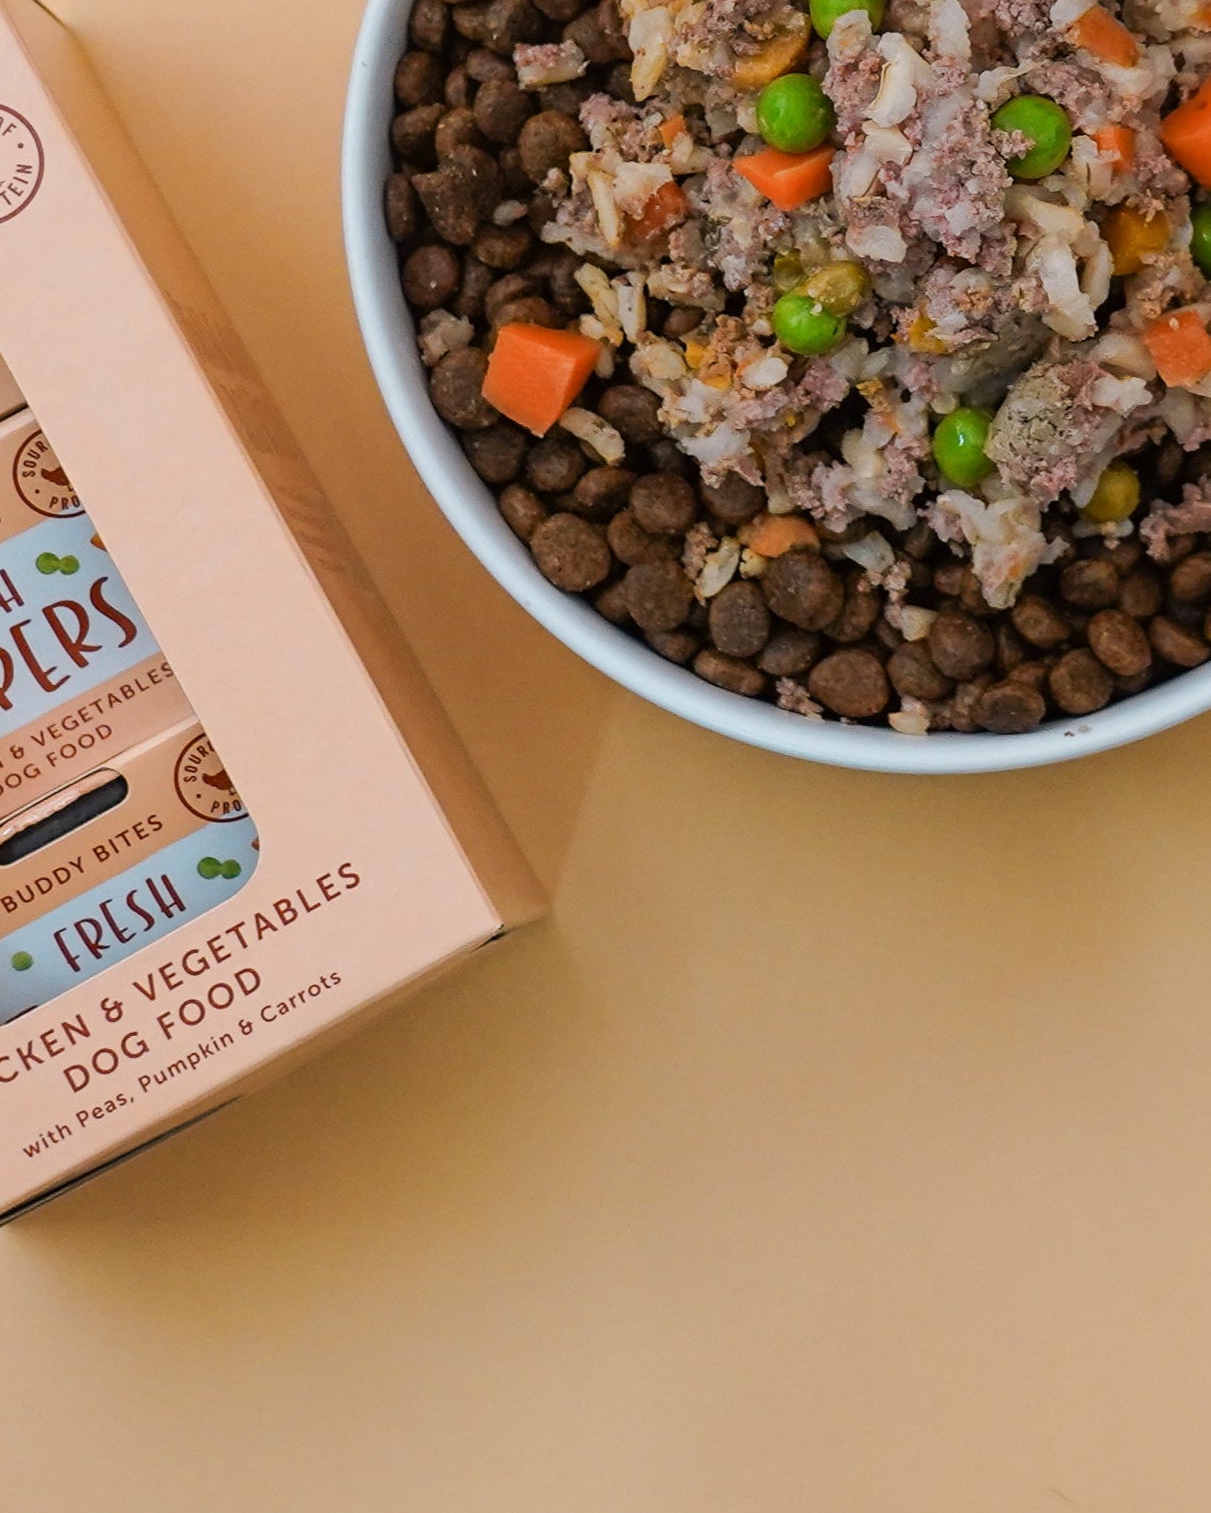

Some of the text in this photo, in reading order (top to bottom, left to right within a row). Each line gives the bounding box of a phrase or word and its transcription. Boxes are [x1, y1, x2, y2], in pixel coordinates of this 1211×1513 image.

[10, 661, 175, 759] & VEGETABLES
[46, 724, 112, 767] FOOD
[0, 814, 163, 913] BUDDY BITES
[53, 874, 186, 973] FRESH
[100, 997, 123, 1023] &
[132, 862, 361, 1001] VEGETABLES
[22, 969, 343, 1158] with Peas, Pumpkin & Carrots
[63, 967, 261, 1093] DOG FOOD
